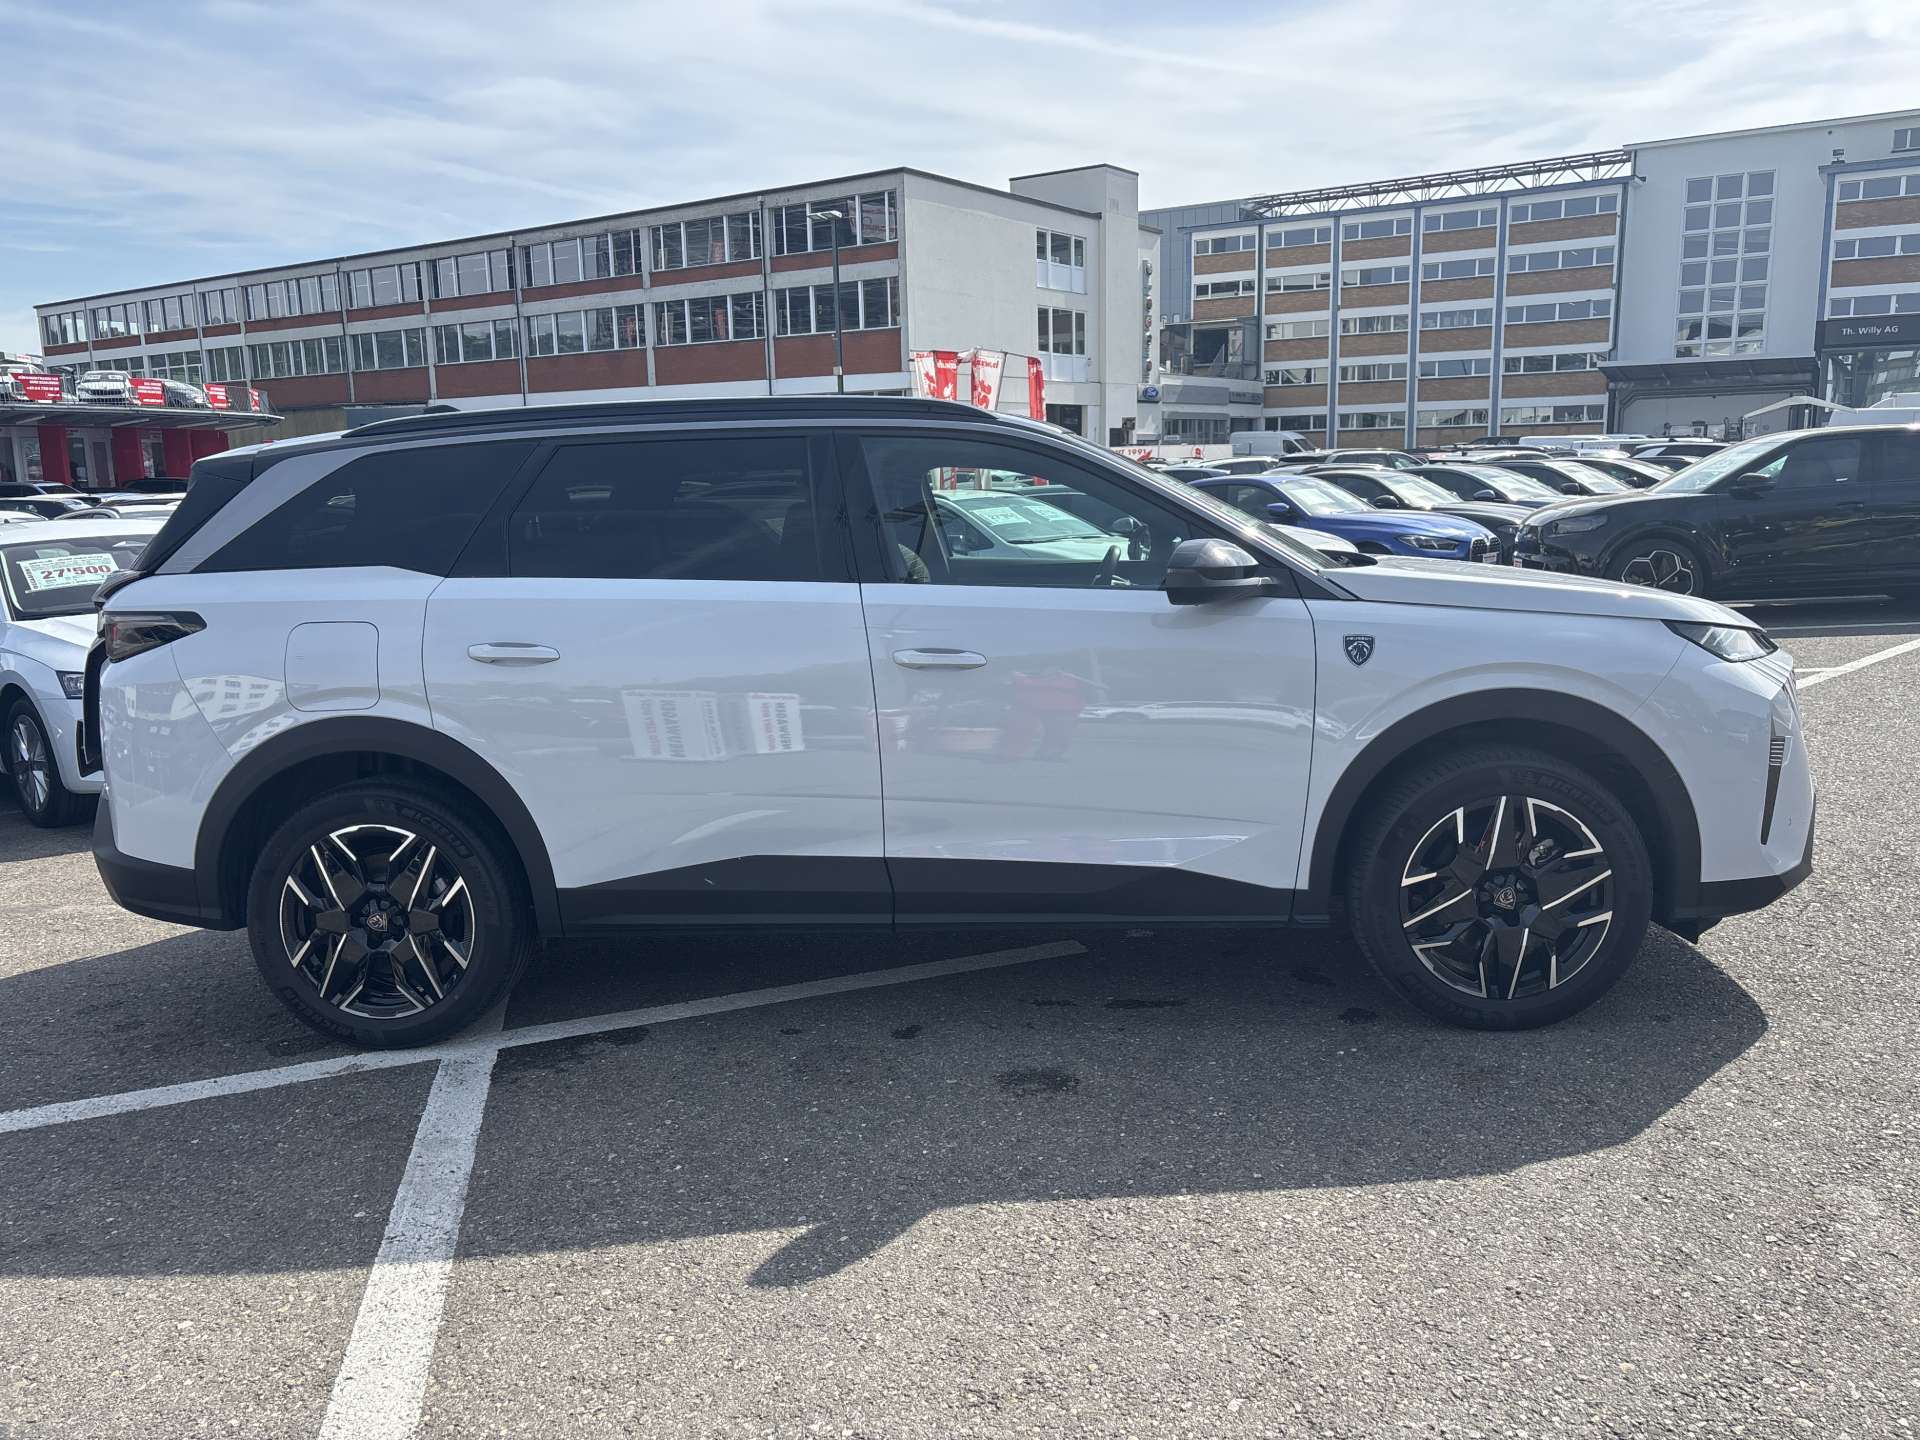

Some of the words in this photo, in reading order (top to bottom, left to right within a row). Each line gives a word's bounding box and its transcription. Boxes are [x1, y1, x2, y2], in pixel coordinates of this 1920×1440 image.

[1841, 327, 1856, 336] Th.
[1858, 325, 1882, 336] Willy
[1884, 325, 1900, 334] AG
[40, 564, 112, 580] 27'500
